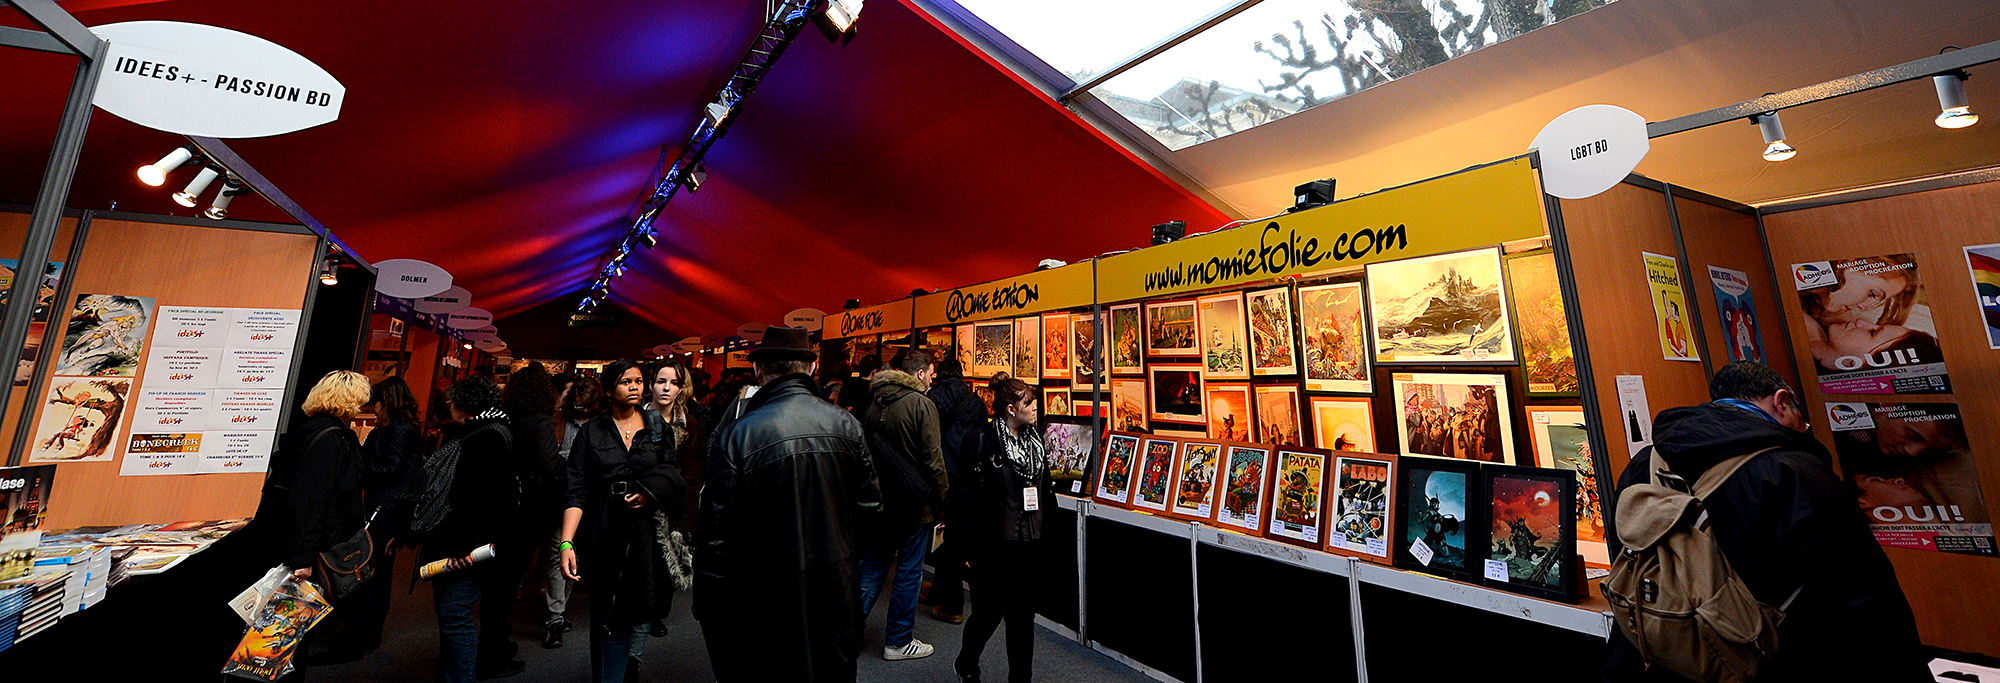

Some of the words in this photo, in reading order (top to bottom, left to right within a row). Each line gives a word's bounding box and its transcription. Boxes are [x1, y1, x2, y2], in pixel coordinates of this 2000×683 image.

[214, 73, 301, 103] PASSION
[304, 88, 332, 108] BD
[1570, 143, 1593, 161] LGBT
[1595, 138, 1609, 154] BD
[1144, 221, 1408, 293] www.momiefolie.com
[1837, 259, 1868, 269] MARIAGE
[1849, 261, 1886, 272] ADOPTION
[1864, 262, 1914, 276] PROCRÉATION
[400, 275, 428, 284] DOLMEN
[1648, 268, 1679, 287] Hitched
[1803, 268, 1832, 281] ADHEOS
[1834, 347, 1920, 371] OUI!
[1874, 405, 1908, 413] MARIAGE
[1888, 409, 1927, 418] ADOPTION
[1838, 411, 1869, 422] ADHEOS
[1903, 413, 1957, 423] PROCRÉATION
[1152, 444, 1169, 454] ZOO
[1288, 455, 1321, 469] PATATA
[1350, 463, 1387, 482] LABO
[1872, 504, 1965, 522] OUI!
